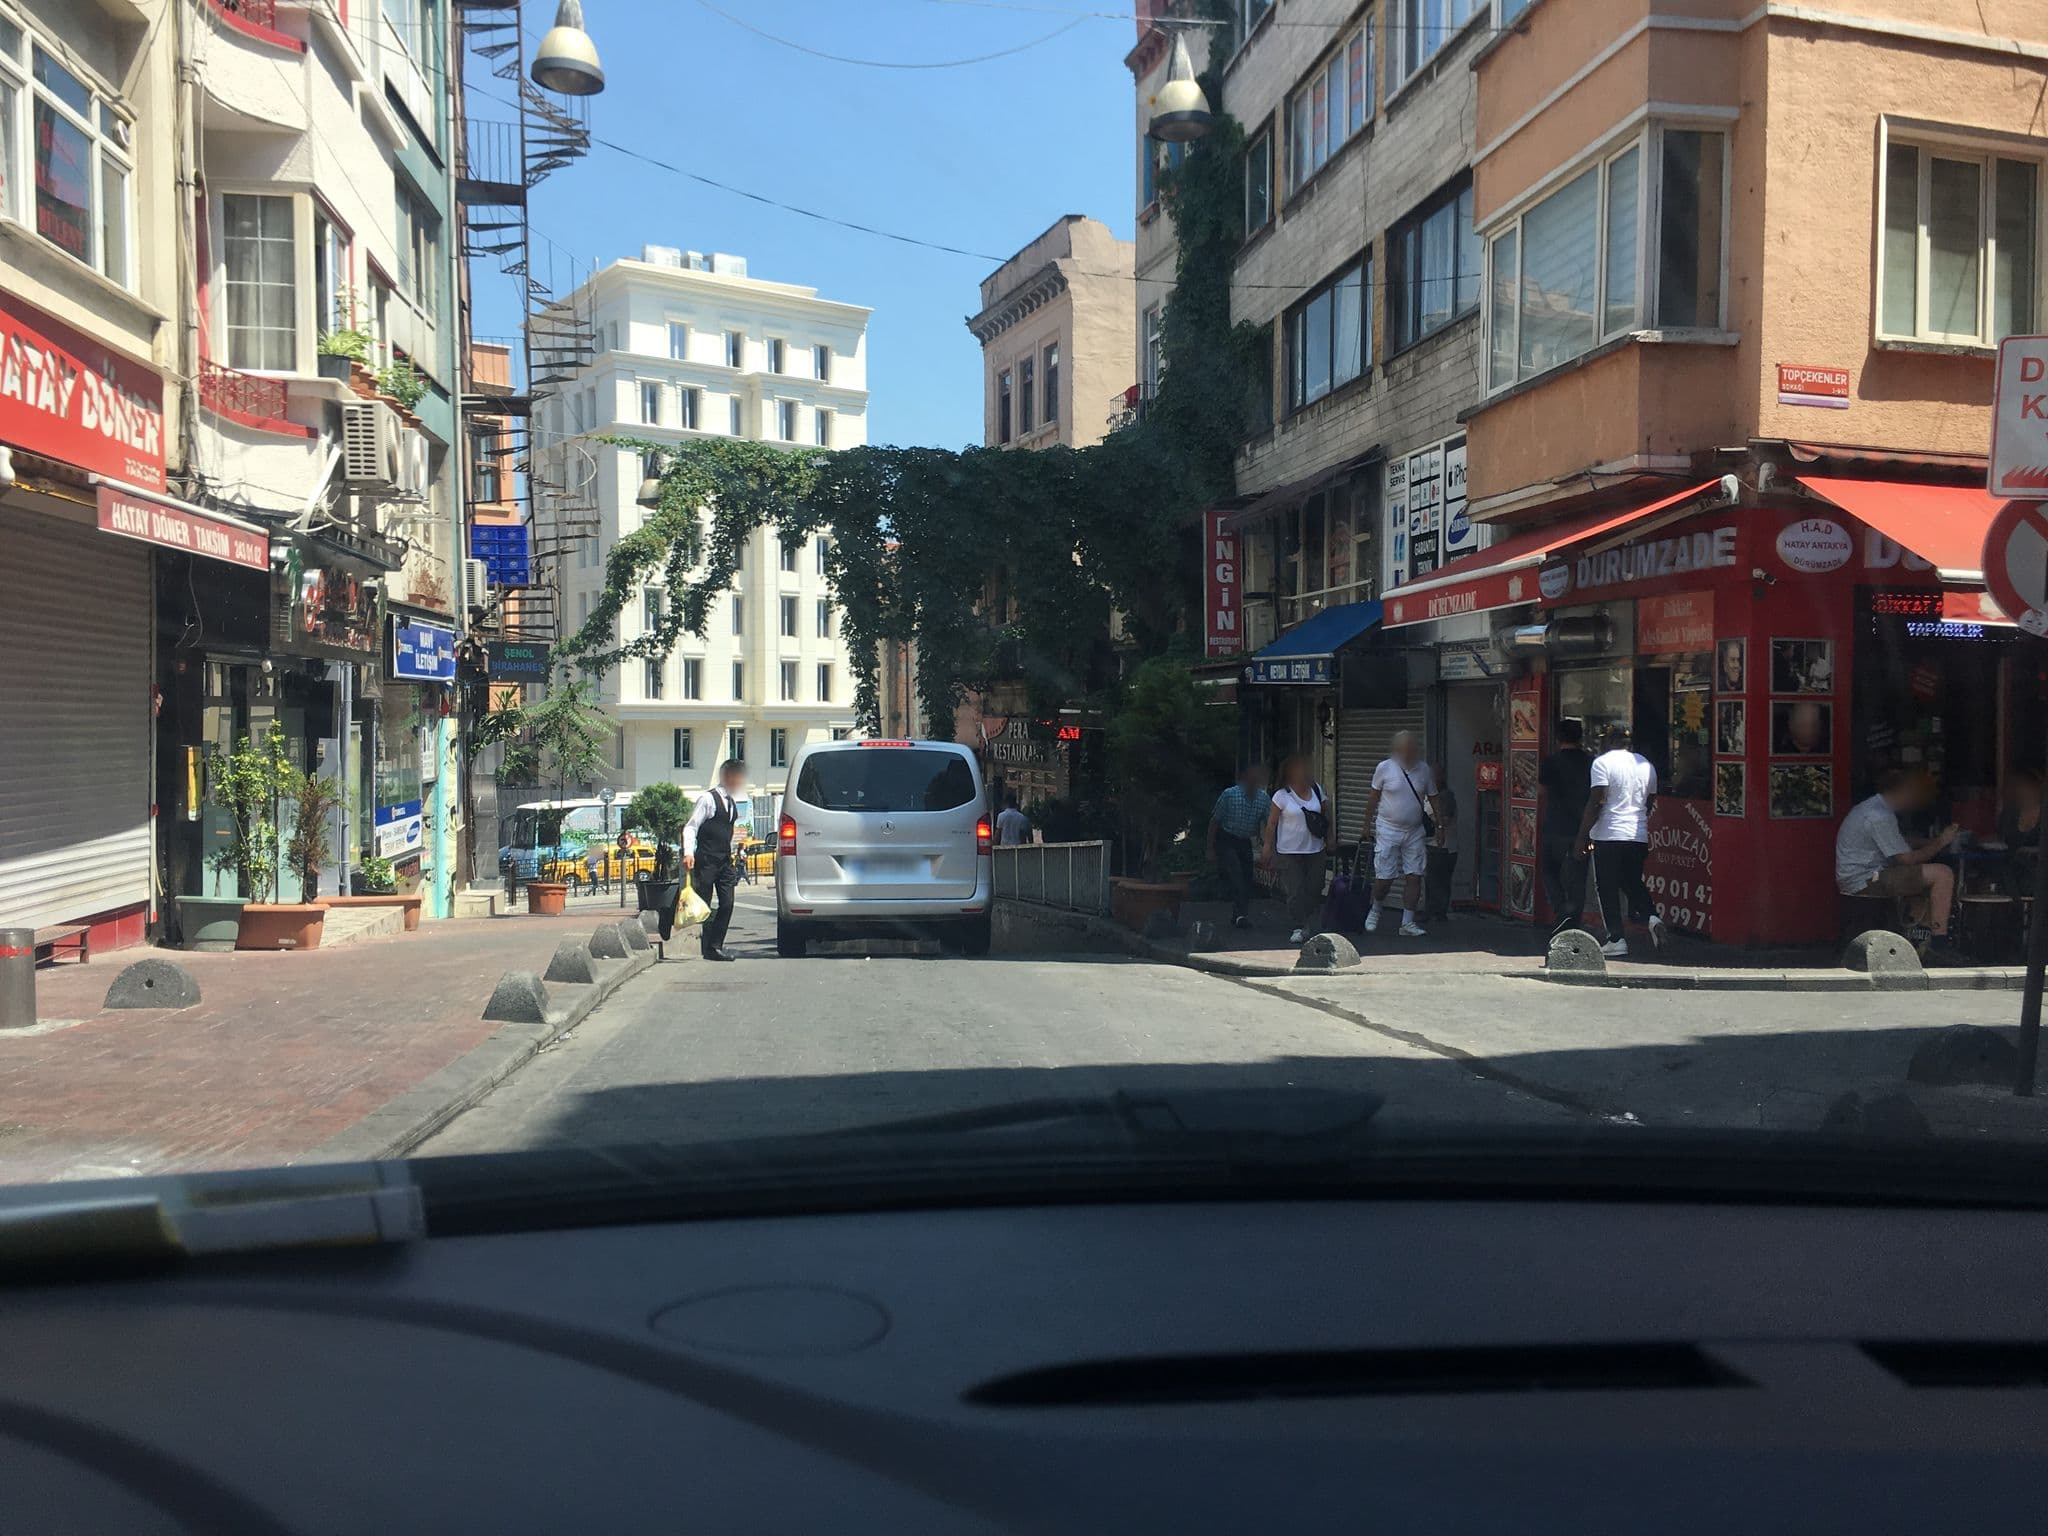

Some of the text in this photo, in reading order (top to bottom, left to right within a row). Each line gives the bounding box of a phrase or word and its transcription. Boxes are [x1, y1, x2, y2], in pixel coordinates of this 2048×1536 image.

[1782, 368, 1847, 386] TOPÇEKENLER
[0, 330, 160, 457] ATAY DÖNER
[2020, 394, 2048, 420] K
[112, 501, 149, 535] HATAY
[152, 508, 190, 546] DÖNER
[194, 524, 230, 558] TAKSİM
[1801, 522, 1833, 535] H.A.D
[1784, 541, 1849, 550] HATAY ANTAKYA
[1793, 556, 1842, 569] DÜRÜMZADE
[1428, 590, 1477, 618] DÜRÜMZADE
[504, 648, 534, 660] ŞENOL
[1008, 722, 1029, 739] PERA
[1669, 879, 1689, 899] 01
[1670, 905, 1691, 927] 99
